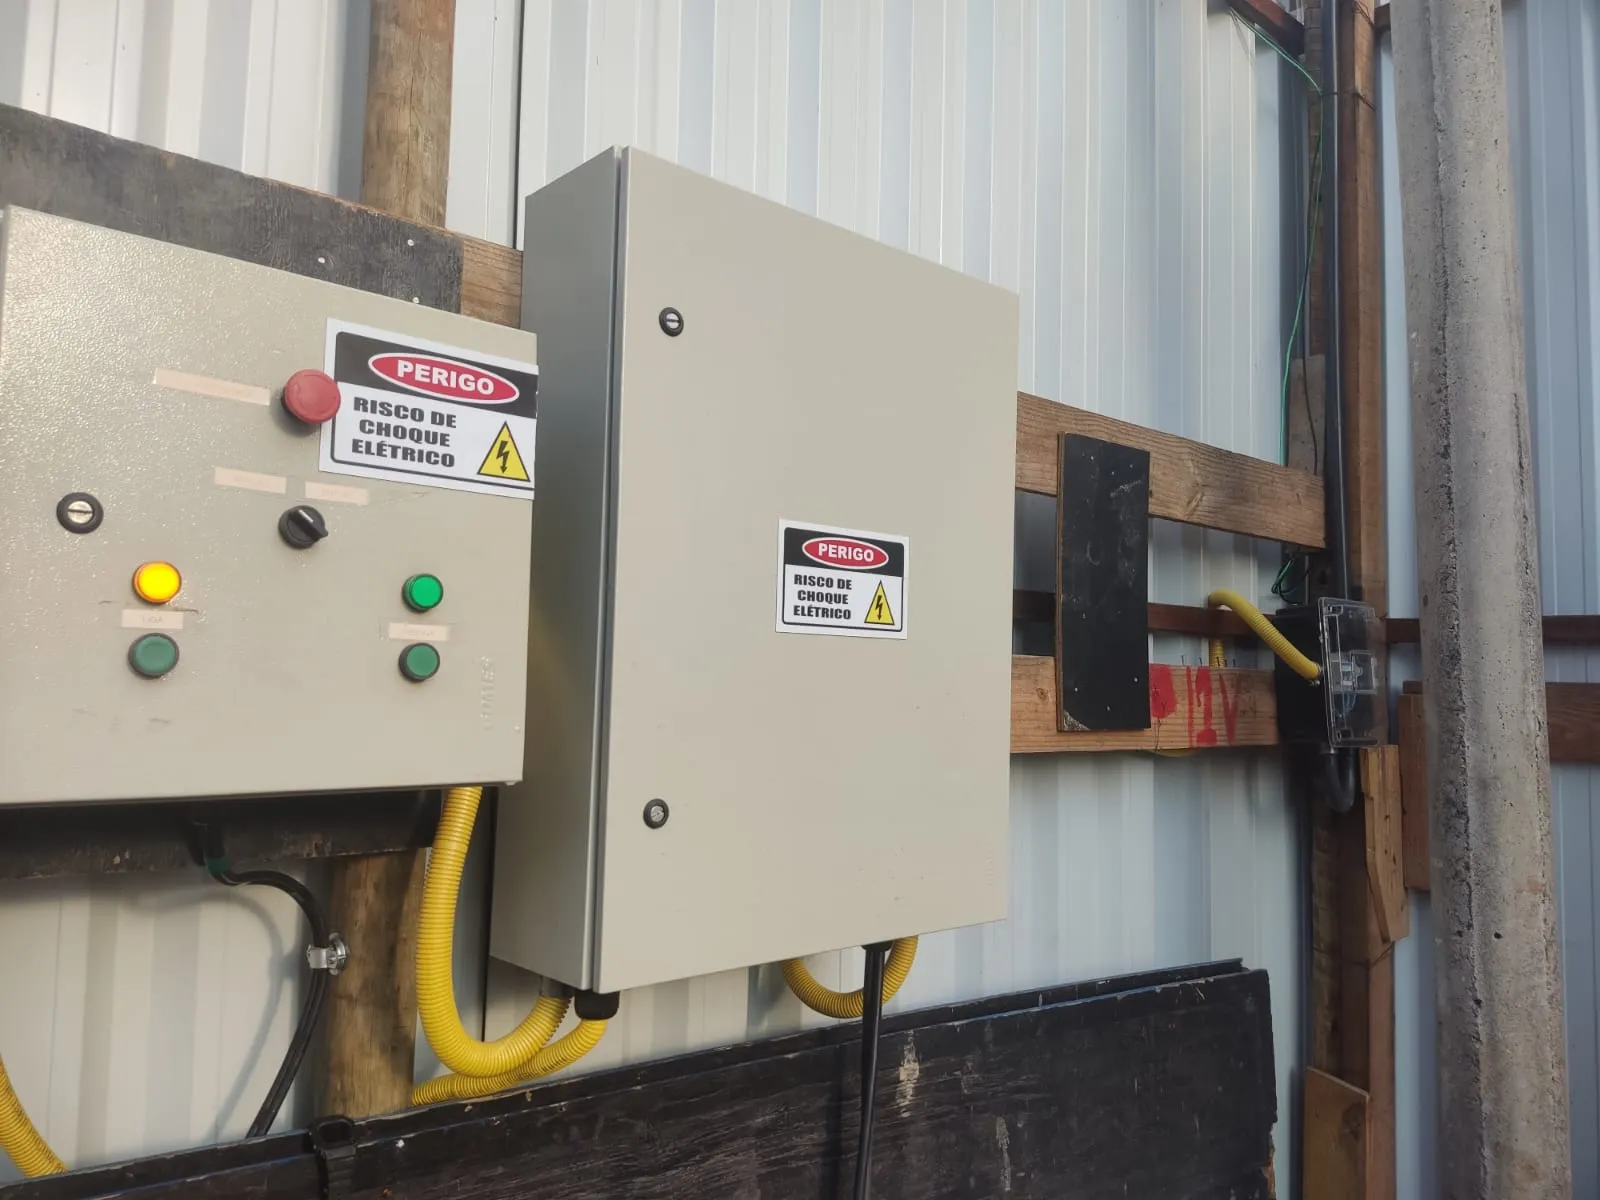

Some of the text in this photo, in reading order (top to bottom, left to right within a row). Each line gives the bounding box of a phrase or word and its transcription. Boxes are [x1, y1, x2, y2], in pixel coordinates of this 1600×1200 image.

[396, 359, 495, 396] PERIGO
[352, 396, 457, 429] RISCO DE
[358, 419, 451, 448] CHOQUE
[351, 438, 455, 468] ELÉTRICO
[817, 542, 875, 562] PERIGO
[793, 574, 853, 591] RISCO DE
[797, 589, 849, 605] CHOQUE
[793, 604, 852, 620] ELÉTRICO
